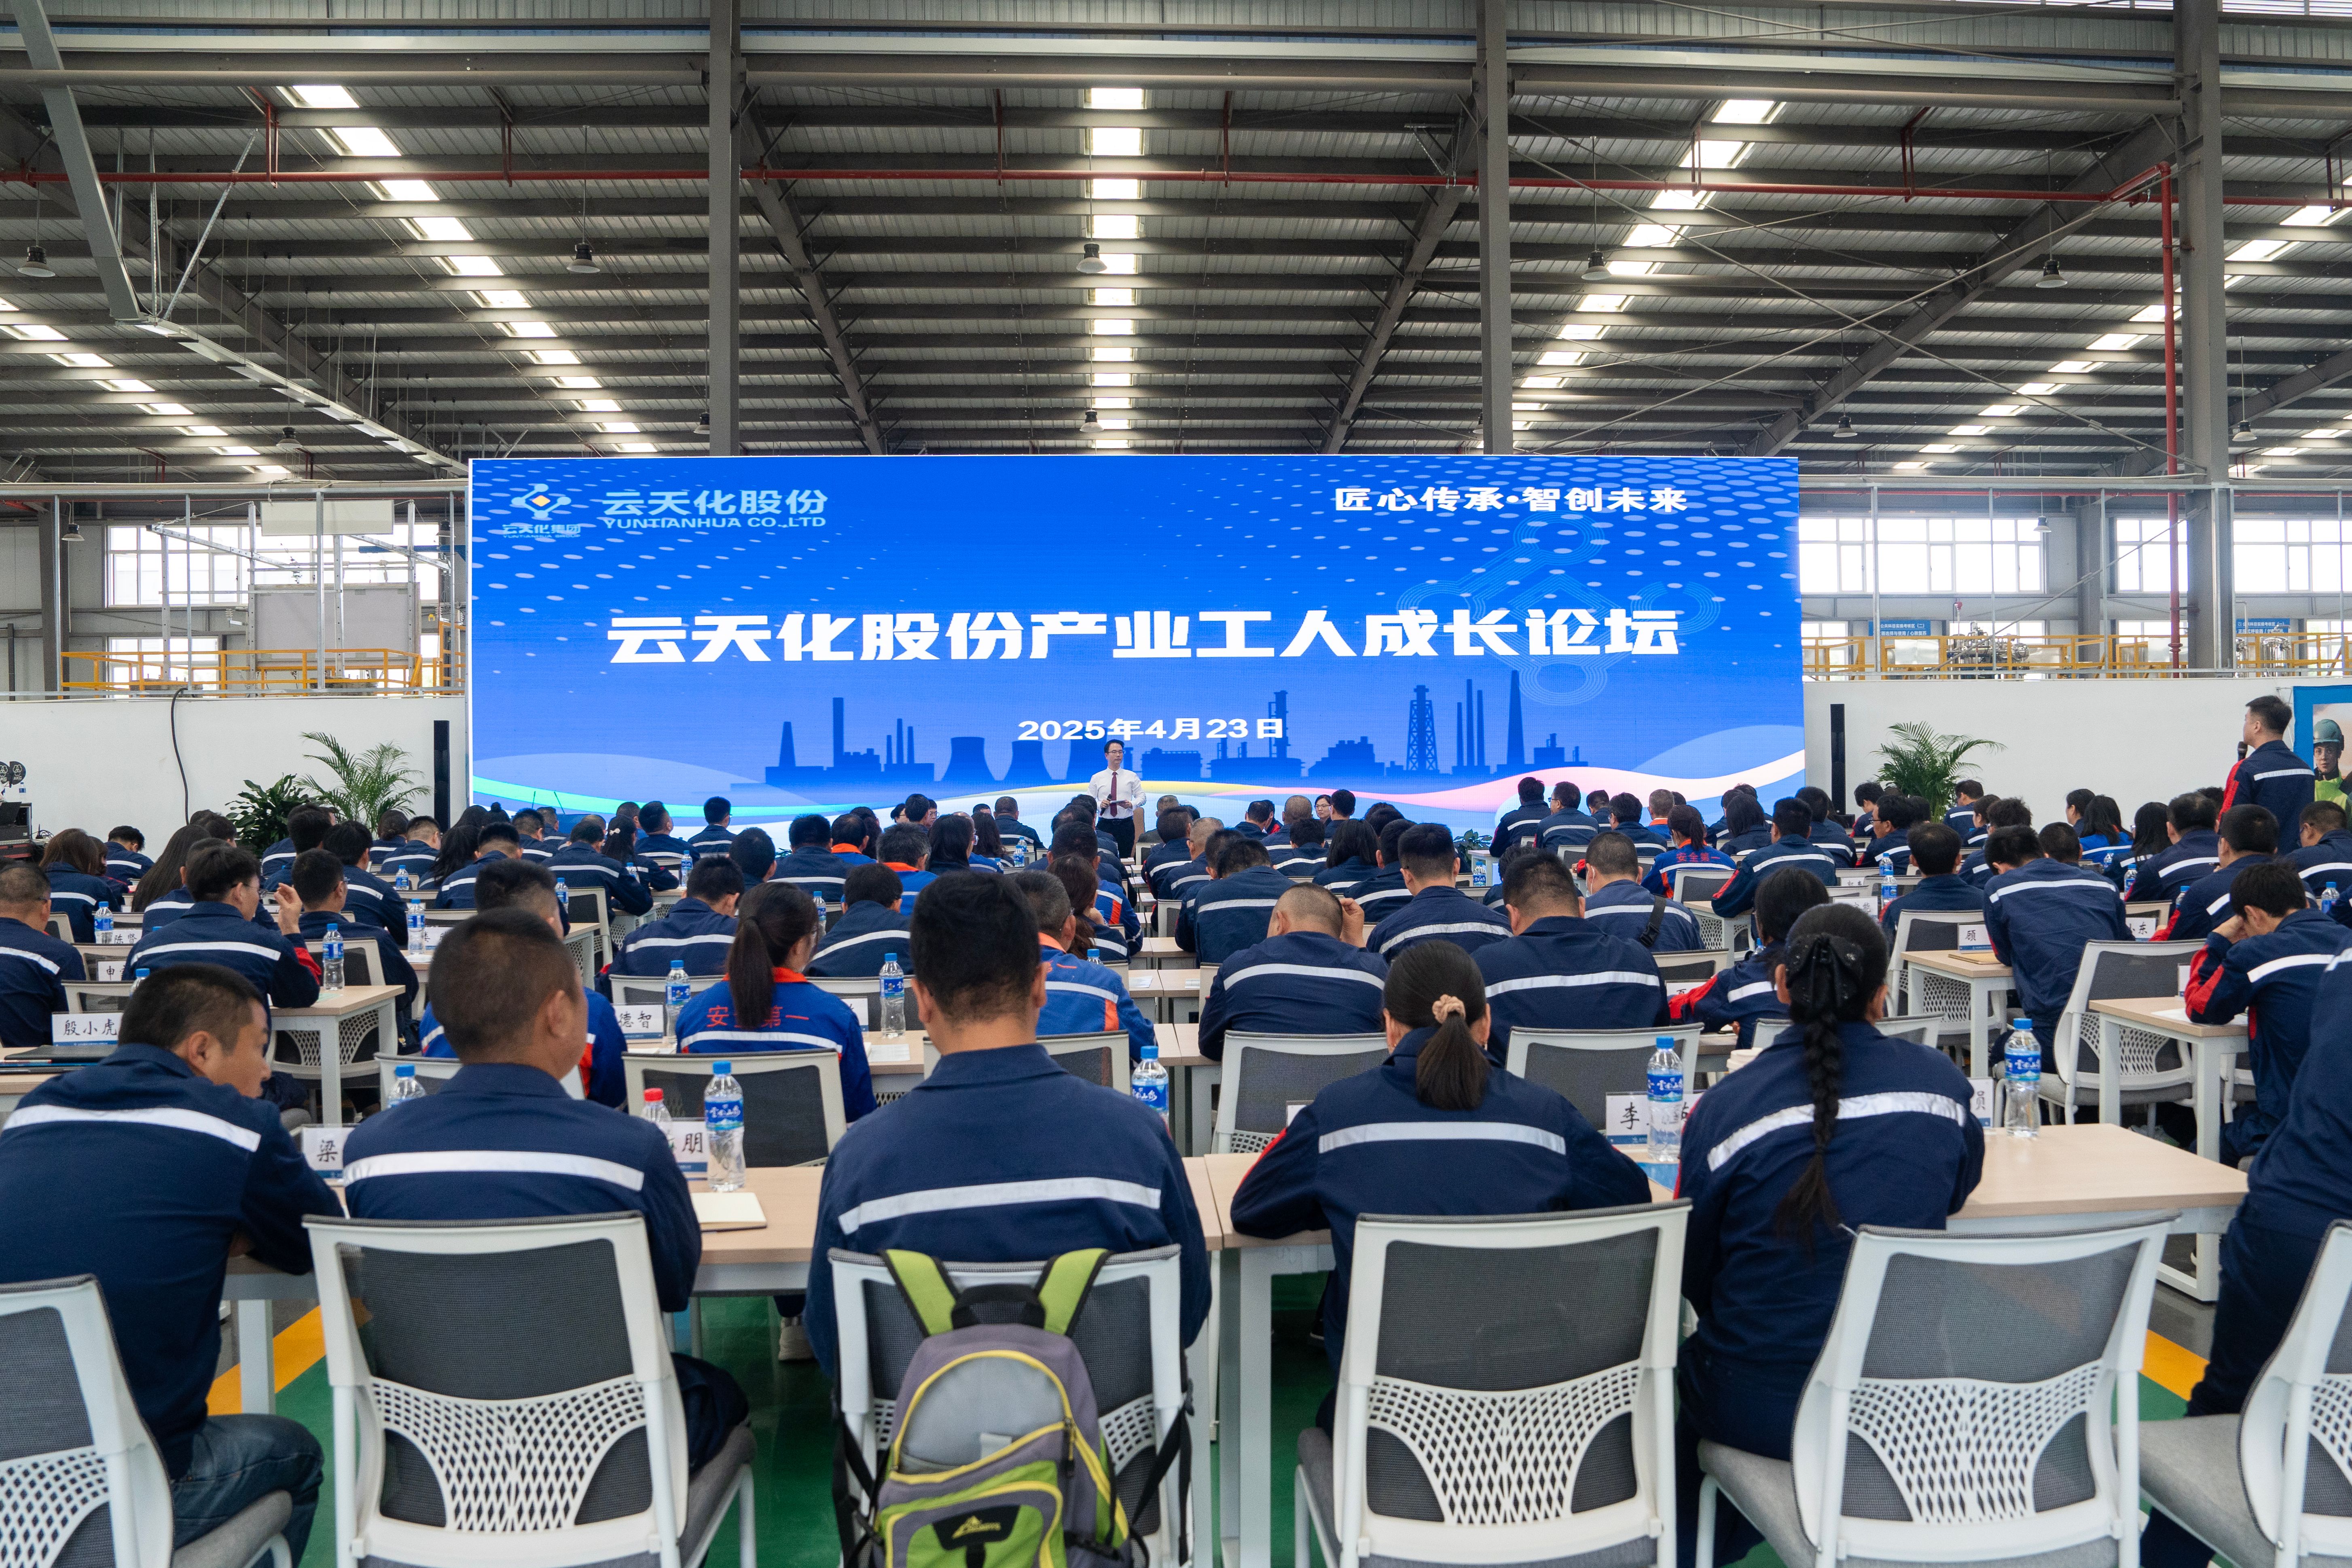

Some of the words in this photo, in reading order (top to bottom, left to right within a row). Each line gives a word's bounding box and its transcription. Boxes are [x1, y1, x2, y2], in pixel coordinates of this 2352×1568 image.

[603, 490, 828, 515] 云天化股份
[1335, 487, 1688, 512] 匠心传承·智创未来
[502, 524, 580, 534] 云天化集团
[605, 518, 742, 529] YUNTIANHUA
[608, 609, 1678, 663] 云天化股份产业工人成长论坛
[1018, 718, 1283, 741] 2025年4月23日
[1676, 852, 1720, 863] 安全第一
[63, 1018, 118, 1035] 殷小虎
[707, 1005, 809, 1028] 安第一
[317, 1139, 338, 1162] 梁
